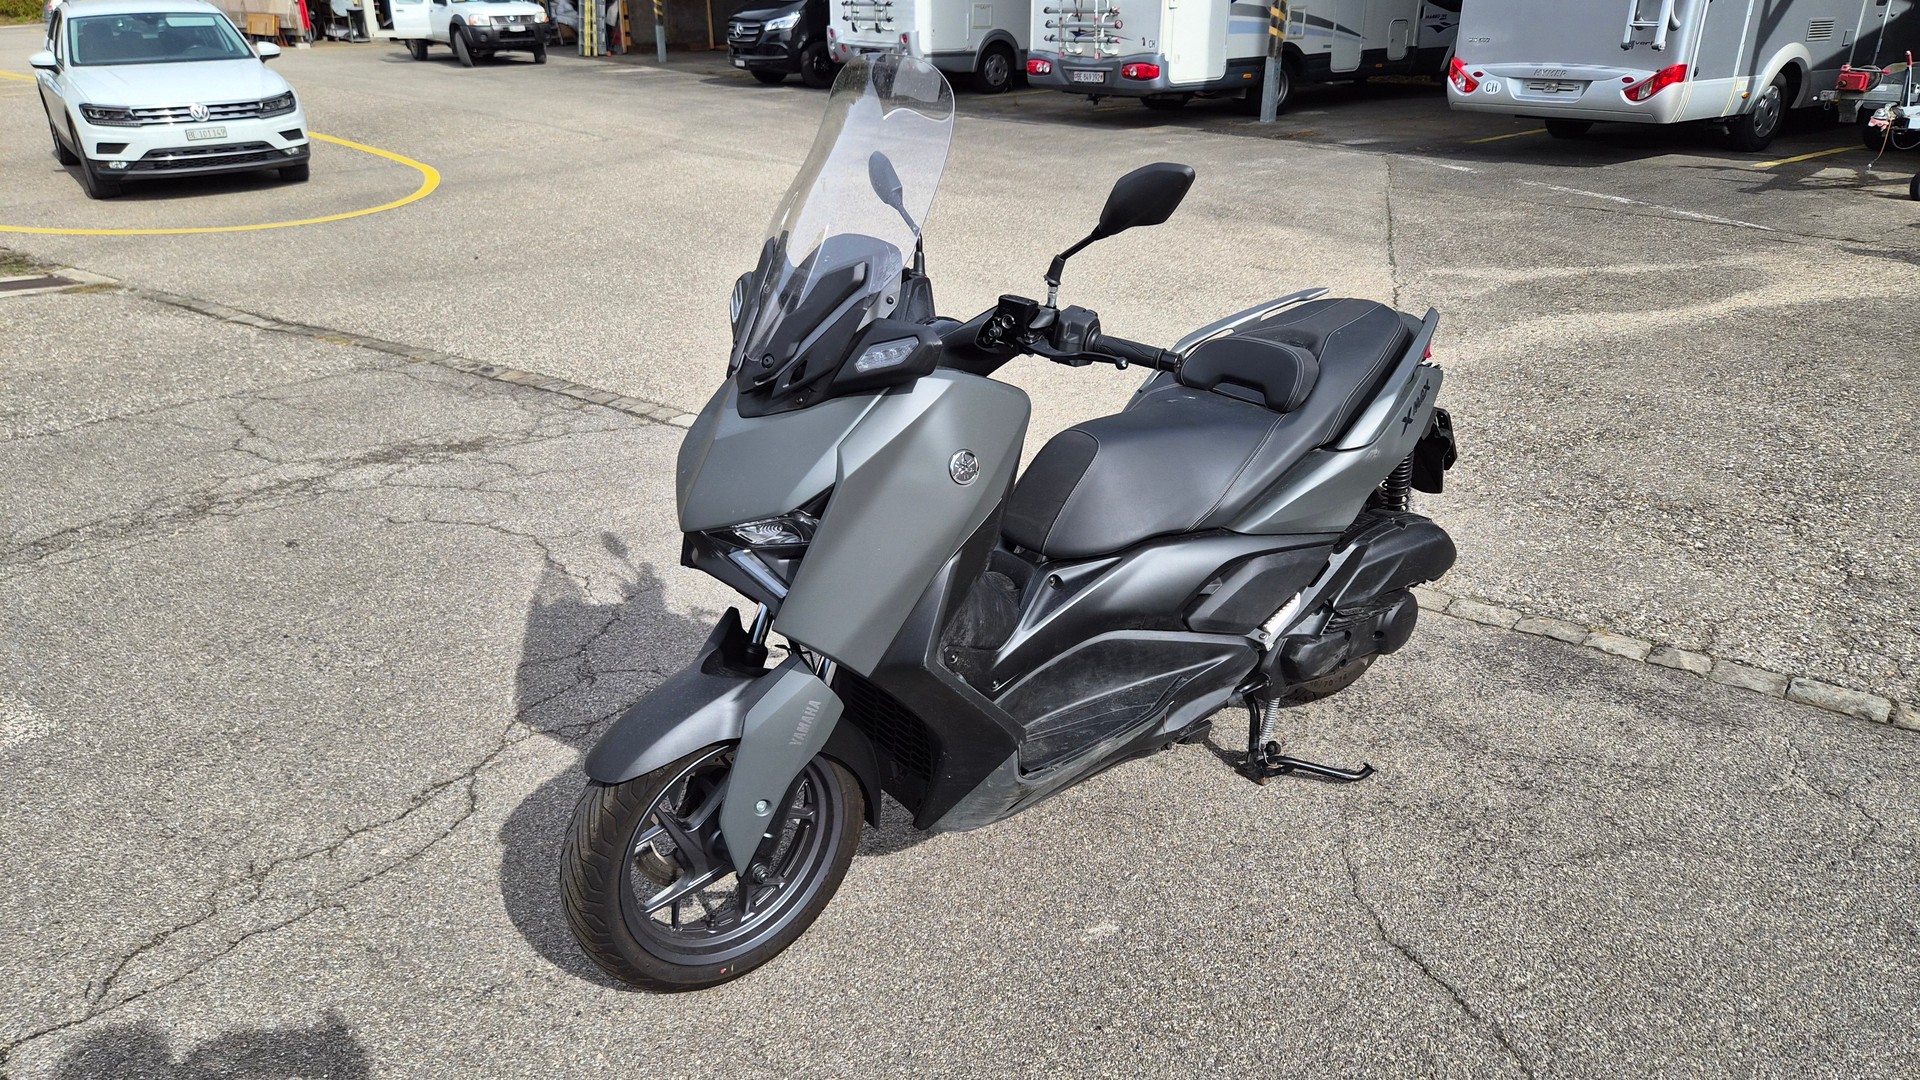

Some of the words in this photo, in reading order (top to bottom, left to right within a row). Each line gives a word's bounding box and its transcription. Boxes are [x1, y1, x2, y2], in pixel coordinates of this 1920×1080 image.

[1533, 68, 1567, 77] HYMER
[1485, 81, 1499, 93] CH
[788, 700, 822, 745] YAMAHA
